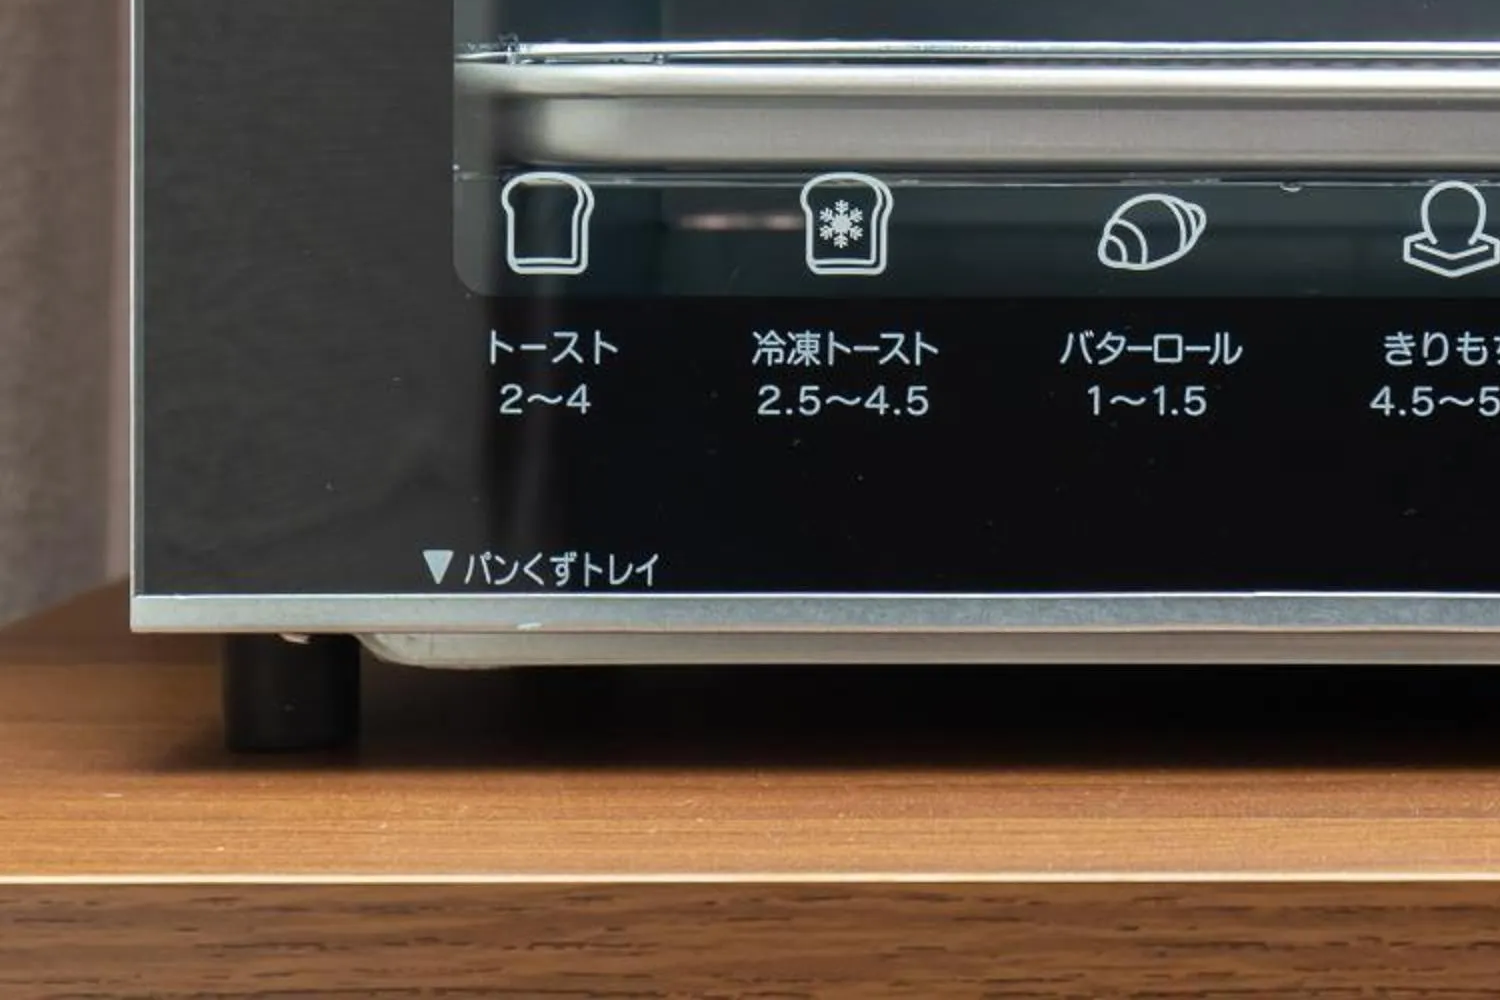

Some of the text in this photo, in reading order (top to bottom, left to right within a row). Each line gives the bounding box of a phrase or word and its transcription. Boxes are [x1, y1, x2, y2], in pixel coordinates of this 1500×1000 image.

[487, 329, 619, 365] トースト
[751, 329, 939, 368] 冷凍トースト
[1059, 329, 1244, 366] バターロール
[463, 550, 659, 587] パンくずトレイ
